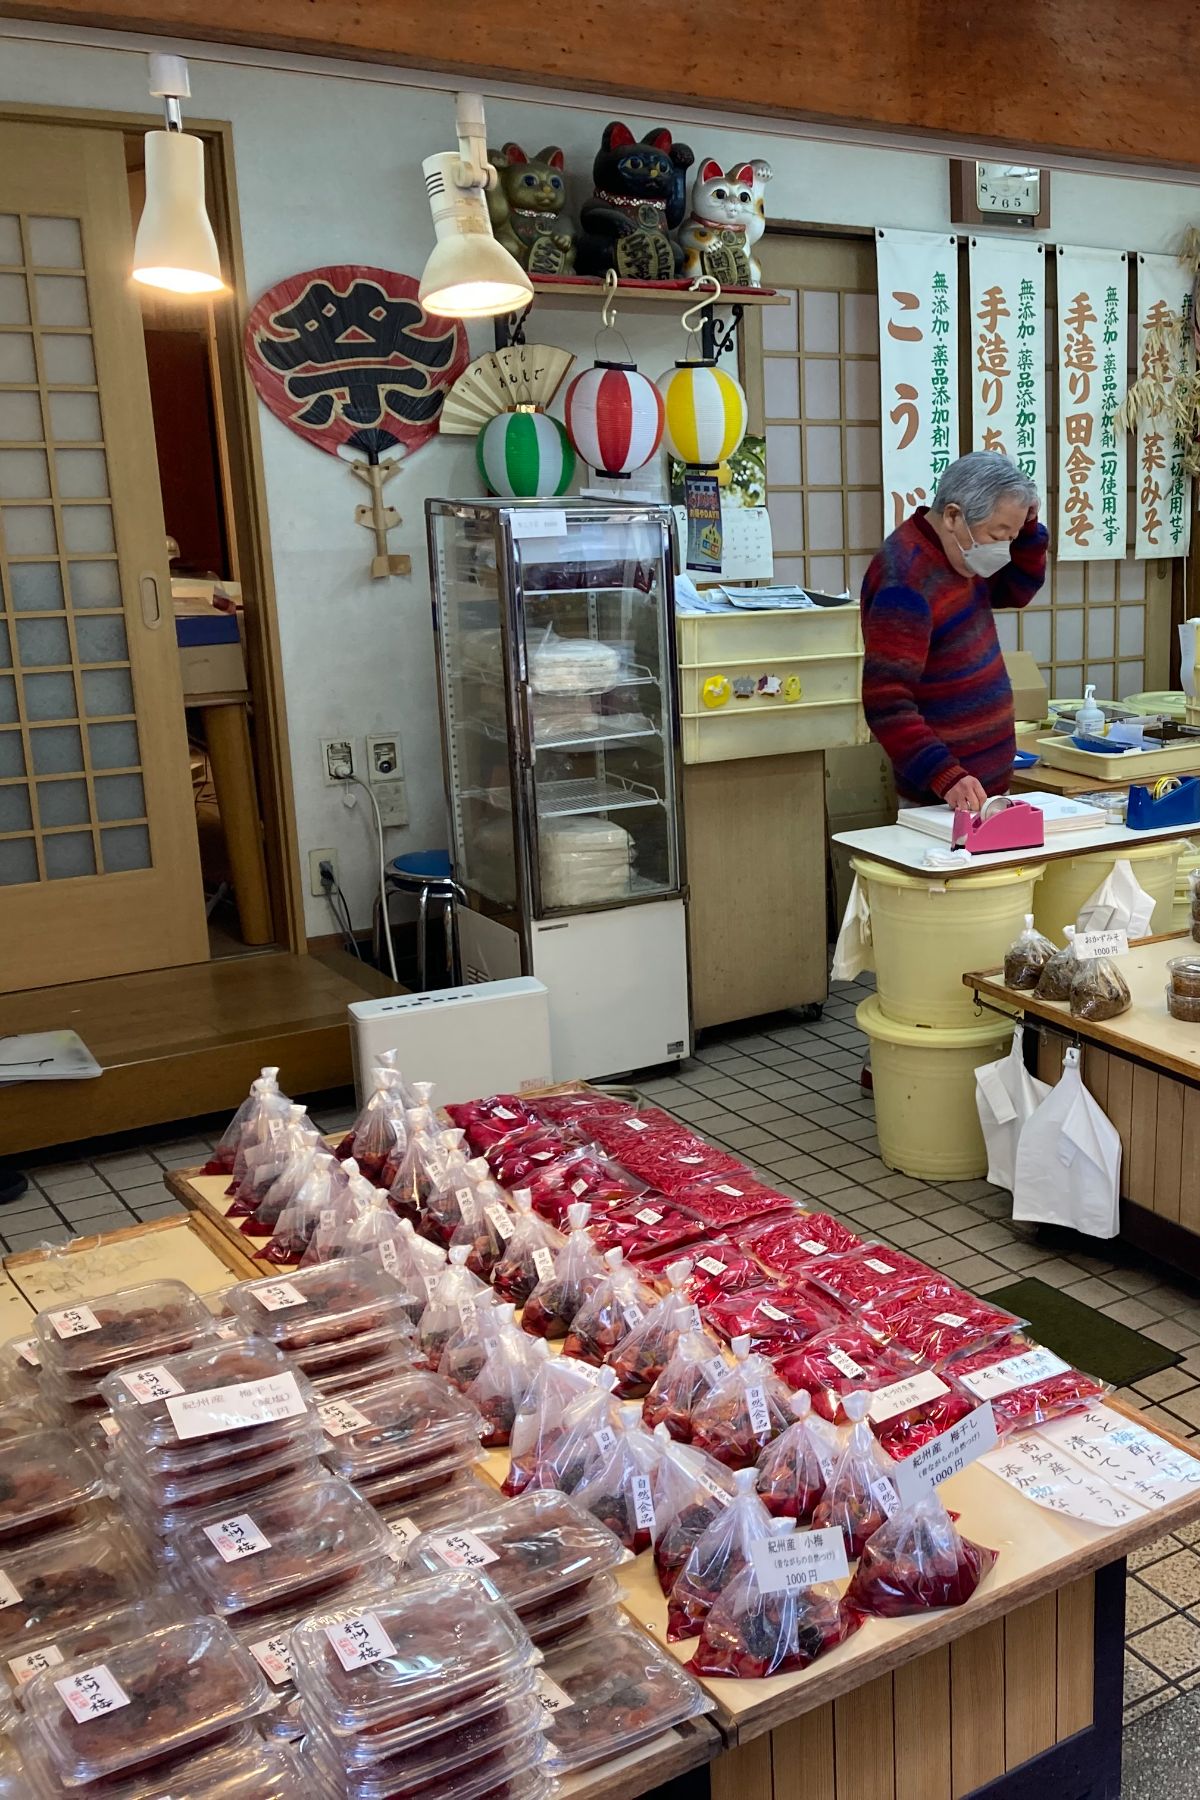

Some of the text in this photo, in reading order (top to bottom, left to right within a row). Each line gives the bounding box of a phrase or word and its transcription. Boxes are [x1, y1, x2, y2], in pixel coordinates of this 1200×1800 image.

[981, 183, 988, 193] 8
[990, 195, 997, 205] 7
[1014, 198, 1021, 208] 5
[1002, 199, 1009, 209] 6
[1100, 286, 1119, 546] 無添加・薬品添加剤一切使用せず
[751, 1389, 769, 1430] 自然食品
[913, 1418, 978, 1469] 紀州産 梅干し
[930, 1457, 964, 1487] 1000円
[637, 1478, 653, 1524] 自然食品
[221, 1521, 256, 1553] 紀州の梅
[767, 1533, 824, 1554] 紀州産 小梅
[785, 1568, 818, 1586] 1000円
[343, 1620, 382, 1662] 紀州の梅
[72, 1673, 114, 1713] 紀州の梅
